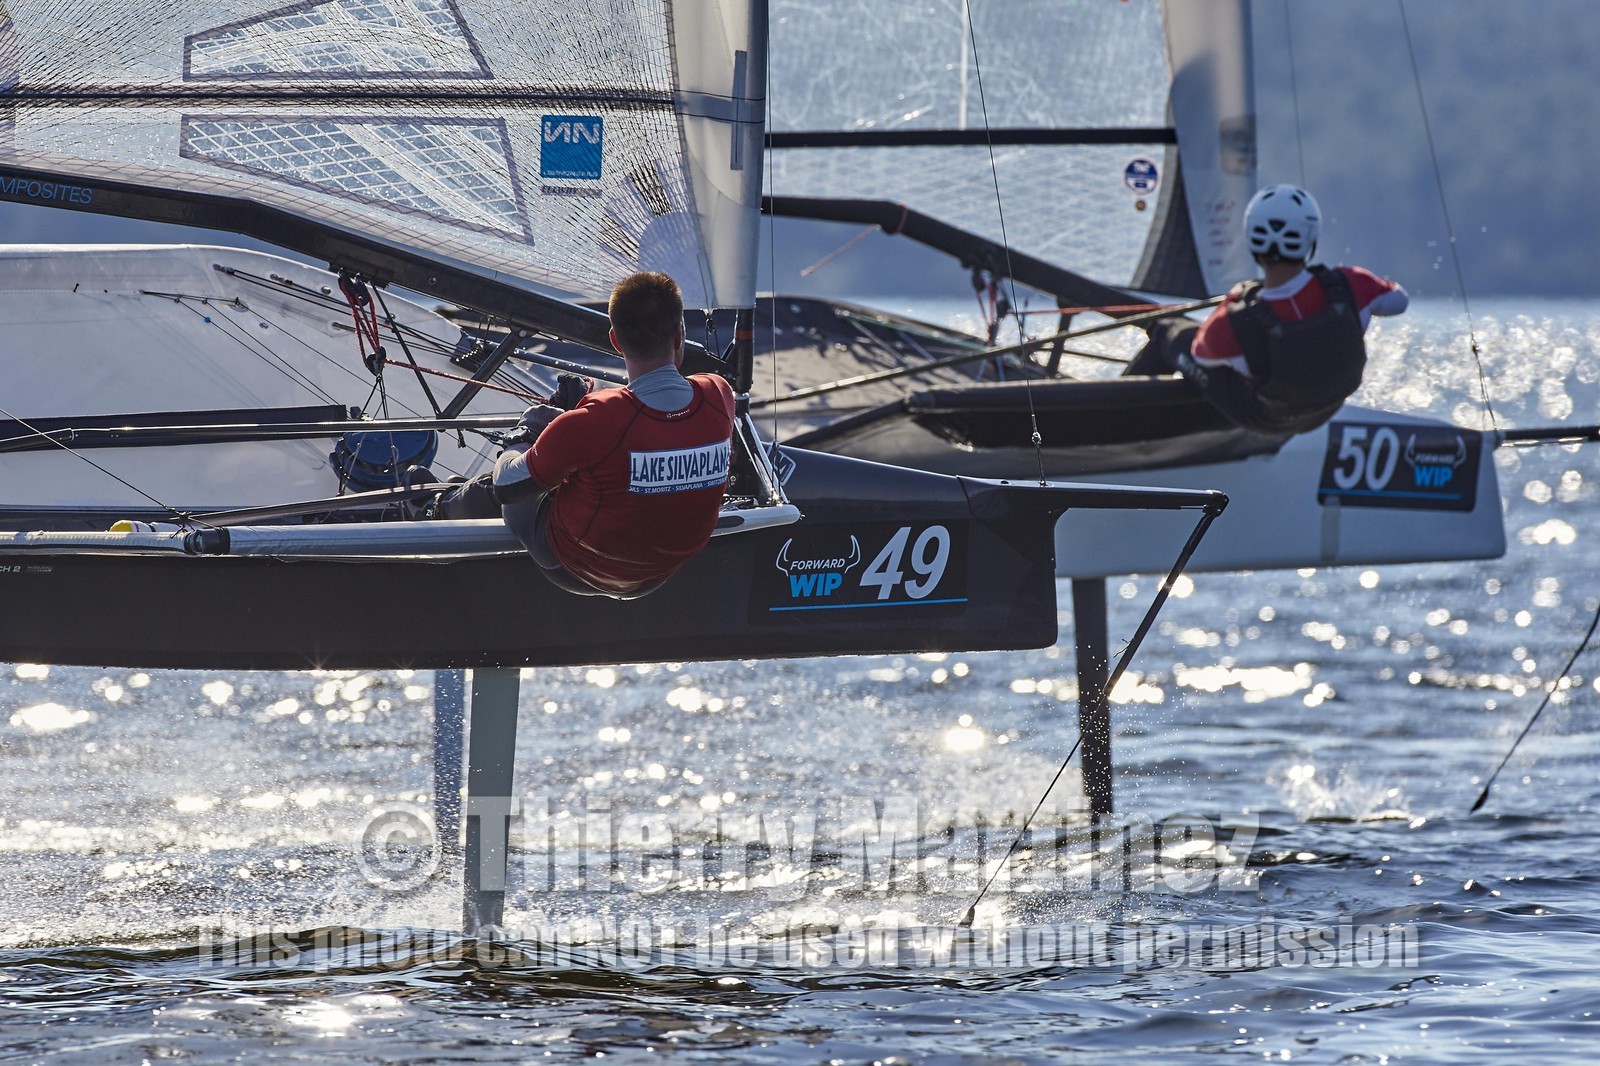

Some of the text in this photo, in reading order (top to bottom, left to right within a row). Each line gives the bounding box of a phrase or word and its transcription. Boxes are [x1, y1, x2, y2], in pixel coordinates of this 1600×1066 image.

[632, 454, 665, 483] LAKE
[1333, 425, 1400, 491] 50
[1414, 465, 1453, 487] WIP
[790, 558, 845, 571] FORWARD
[859, 524, 951, 600] 49
[789, 572, 843, 598] WIP
